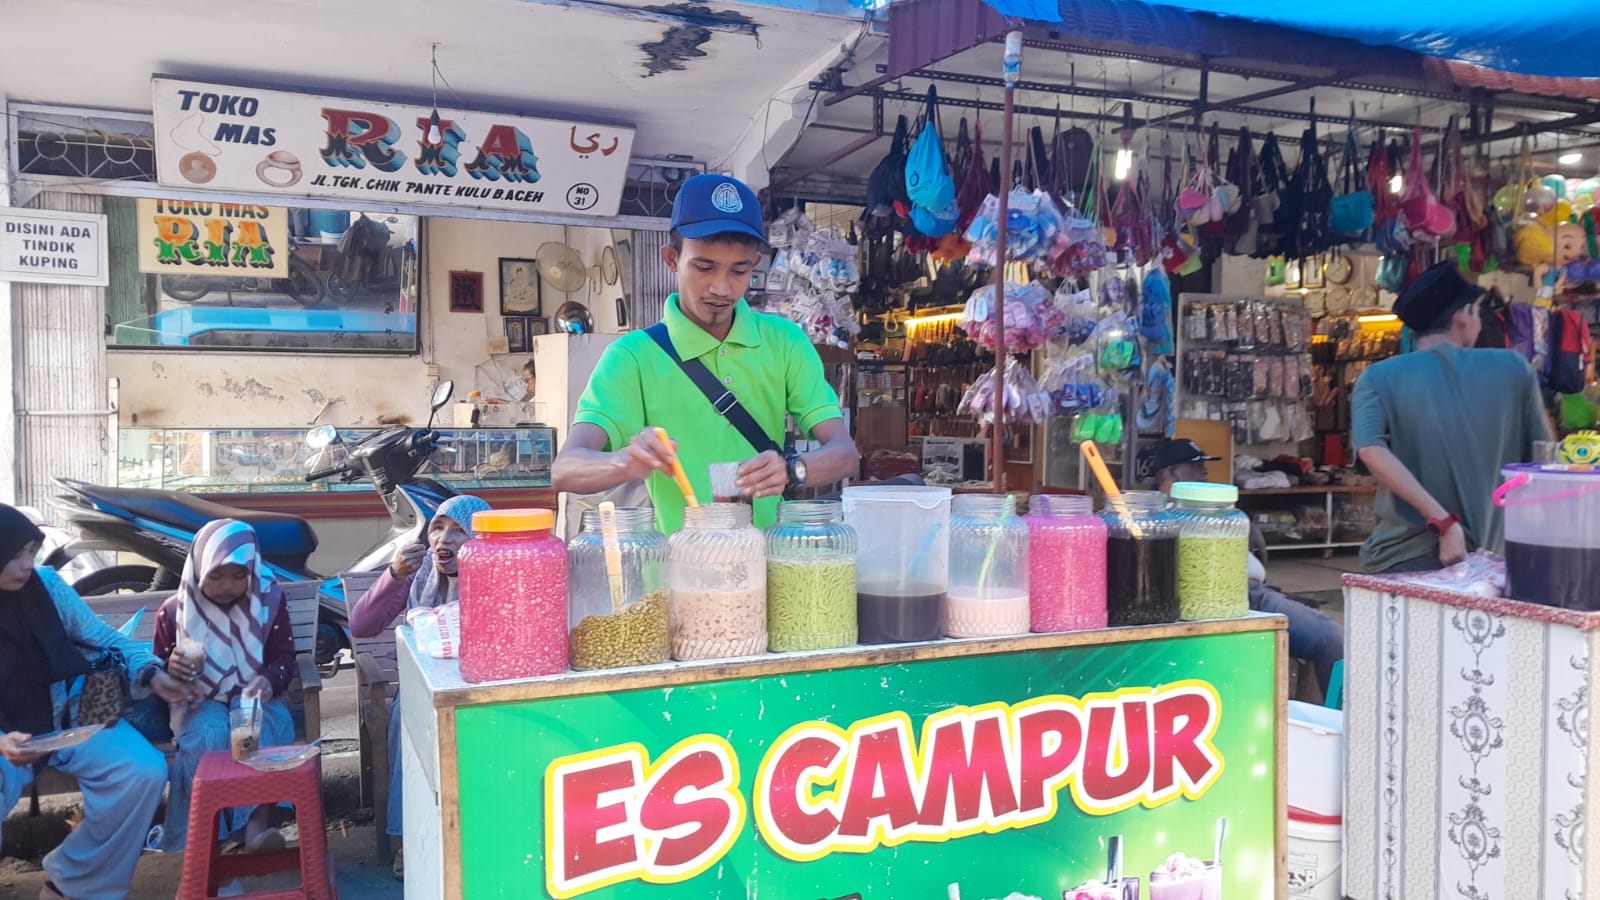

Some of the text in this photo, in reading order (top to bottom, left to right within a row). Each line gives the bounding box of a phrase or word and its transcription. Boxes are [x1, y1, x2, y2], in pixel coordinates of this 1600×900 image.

[177, 90, 259, 117] TOKO
[214, 122, 276, 146] MAS
[319, 107, 542, 184] RIA
[405, 181, 453, 196] PANTE
[455, 185, 492, 199] KULU
[573, 197, 586, 206] 31
[5, 222, 91, 239] DISINI ADA
[22, 239, 75, 253] TINDIK
[153, 216, 275, 269] RIA
[19, 255, 79, 269] KUPING
[554, 686, 1220, 889] ES CAMPUR
